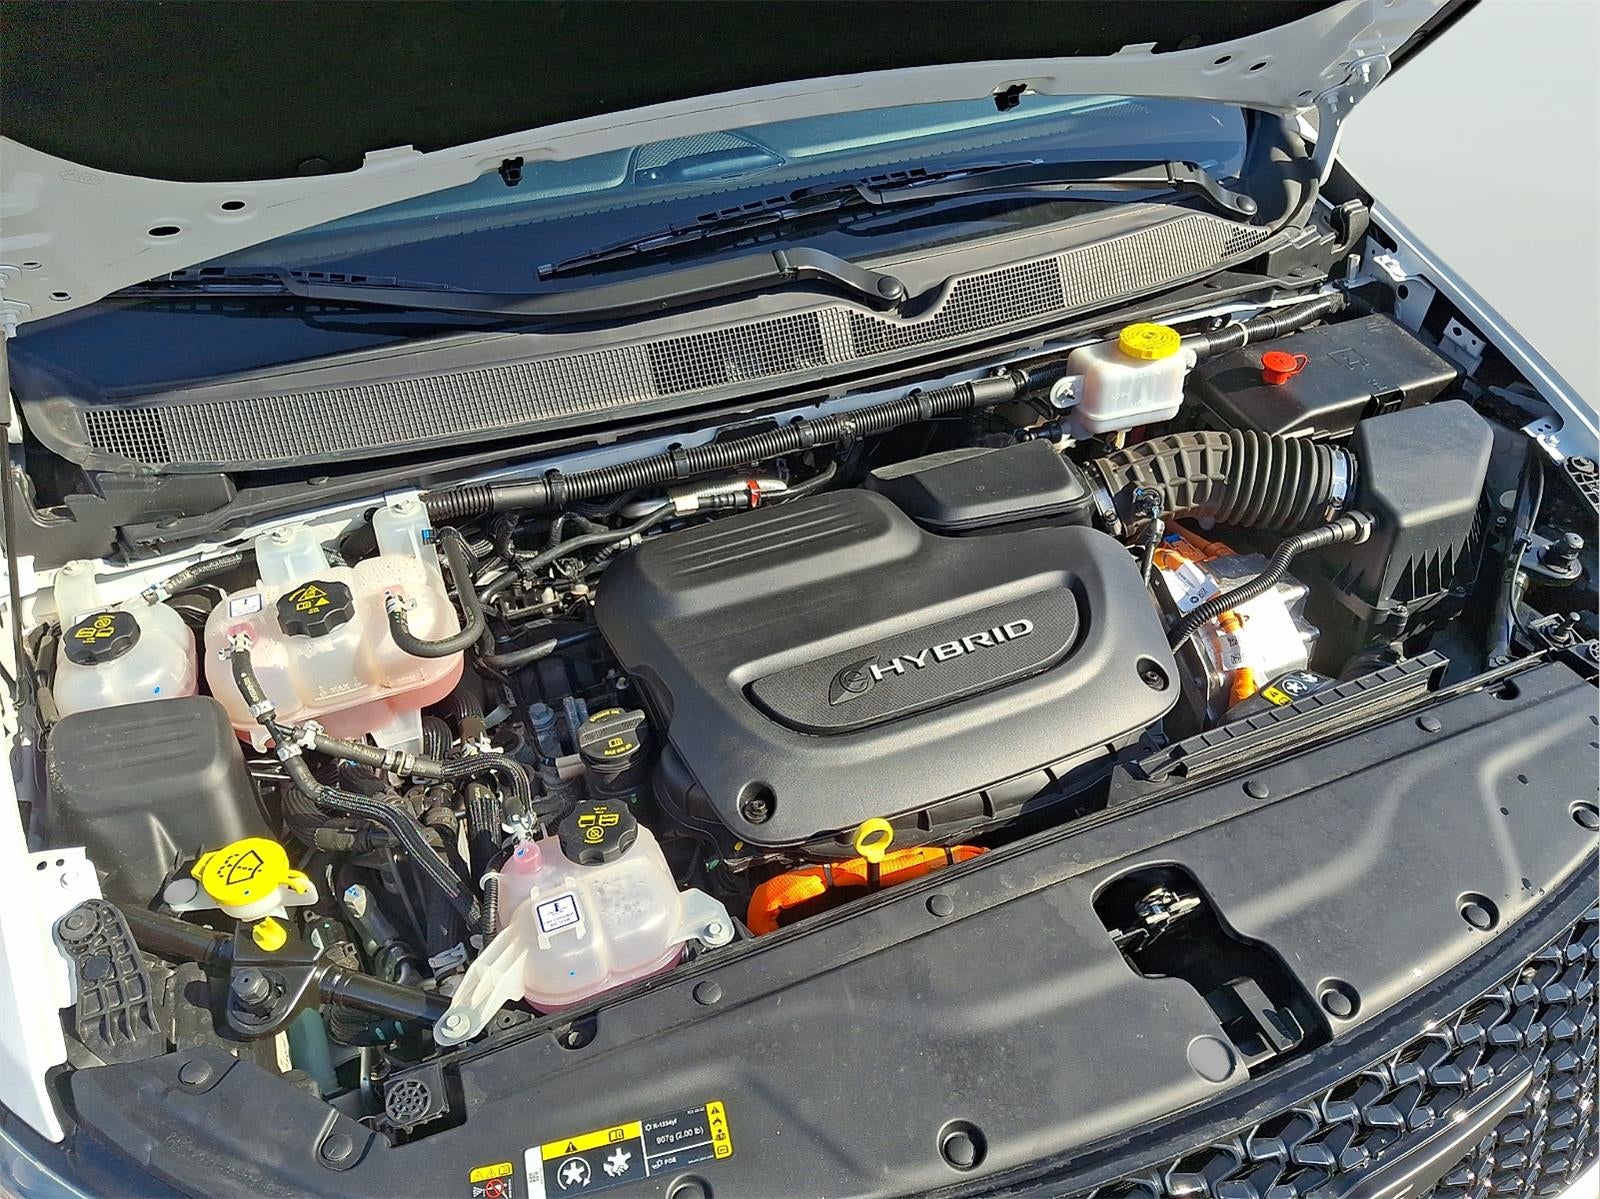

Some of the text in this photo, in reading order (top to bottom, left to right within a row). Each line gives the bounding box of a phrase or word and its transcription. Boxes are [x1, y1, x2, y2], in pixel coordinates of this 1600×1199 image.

[656, 1126, 704, 1145] 907g (2.00 lb)
